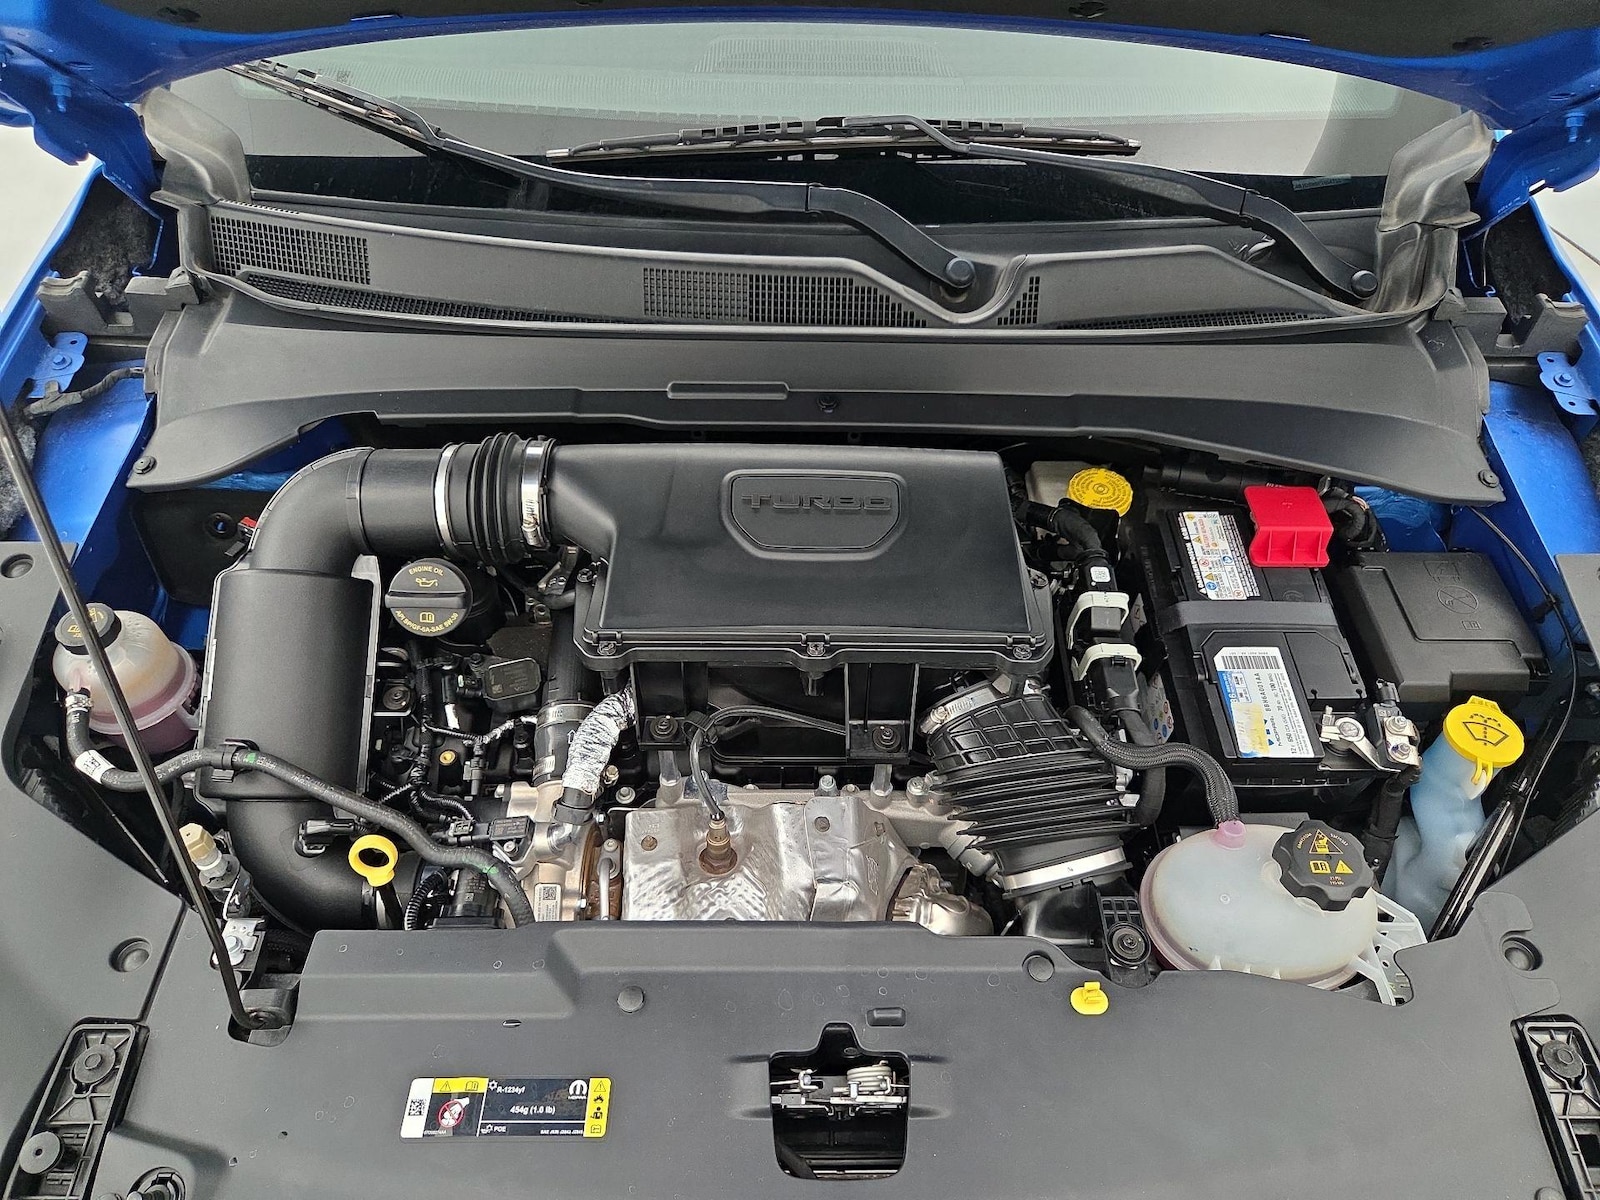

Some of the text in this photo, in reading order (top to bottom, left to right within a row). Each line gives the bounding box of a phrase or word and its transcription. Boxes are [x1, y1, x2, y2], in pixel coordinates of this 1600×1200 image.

[741, 493, 892, 510] TURBO
[408, 566, 444, 576] ENGINE OIL
[497, 1086, 525, 1094] R-1234yf
[510, 1105, 556, 1115] 454g (1.0 lb)
